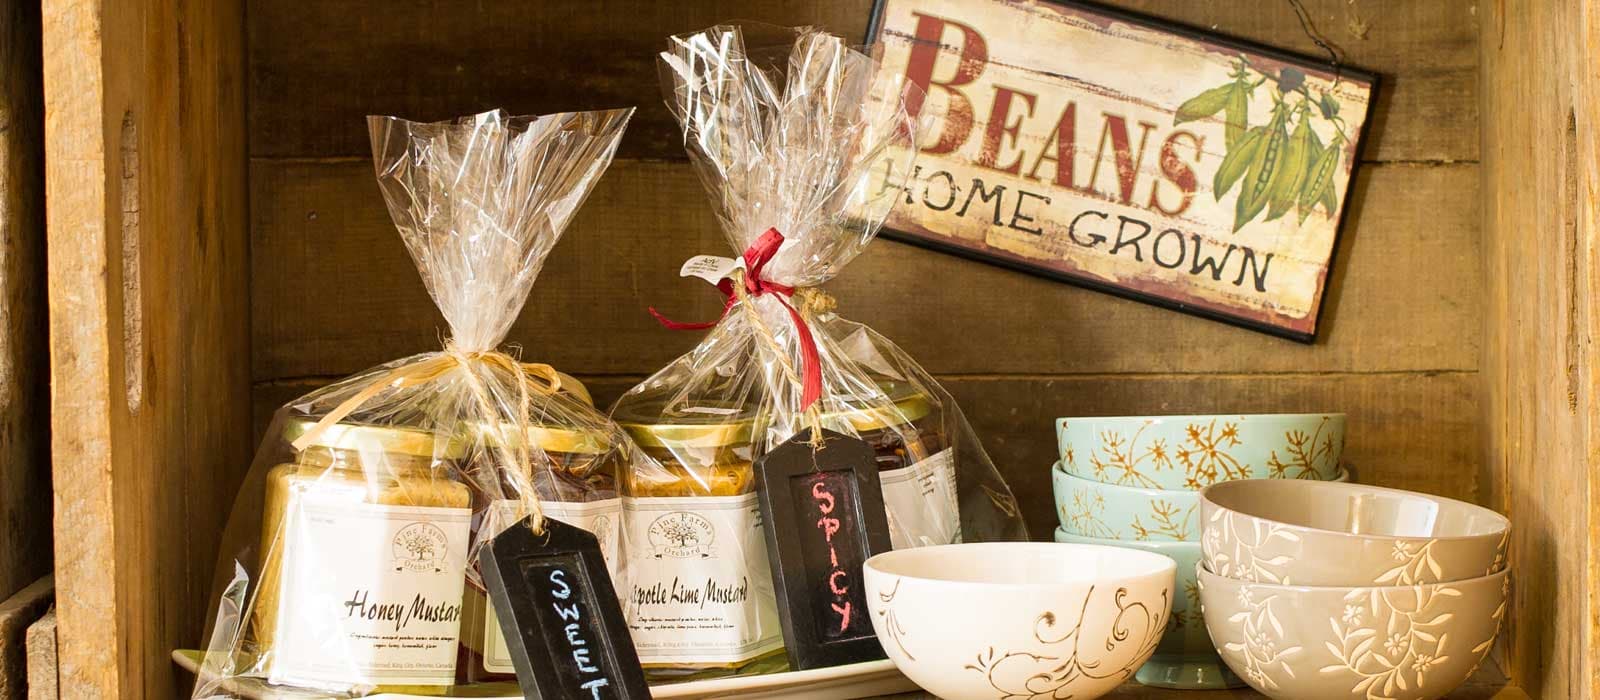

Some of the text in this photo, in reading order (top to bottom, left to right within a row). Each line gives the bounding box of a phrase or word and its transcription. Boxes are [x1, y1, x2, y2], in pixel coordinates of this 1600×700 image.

[876, 158, 1274, 293] HOME GROWN
[651, 513, 712, 535] Pine Farms
[812, 482, 851, 632] SPICY
[344, 590, 461, 632] Honey Mustar
[549, 569, 609, 700] SWEET
[670, 576, 699, 604] Lime
[700, 576, 748, 610] Mustard
